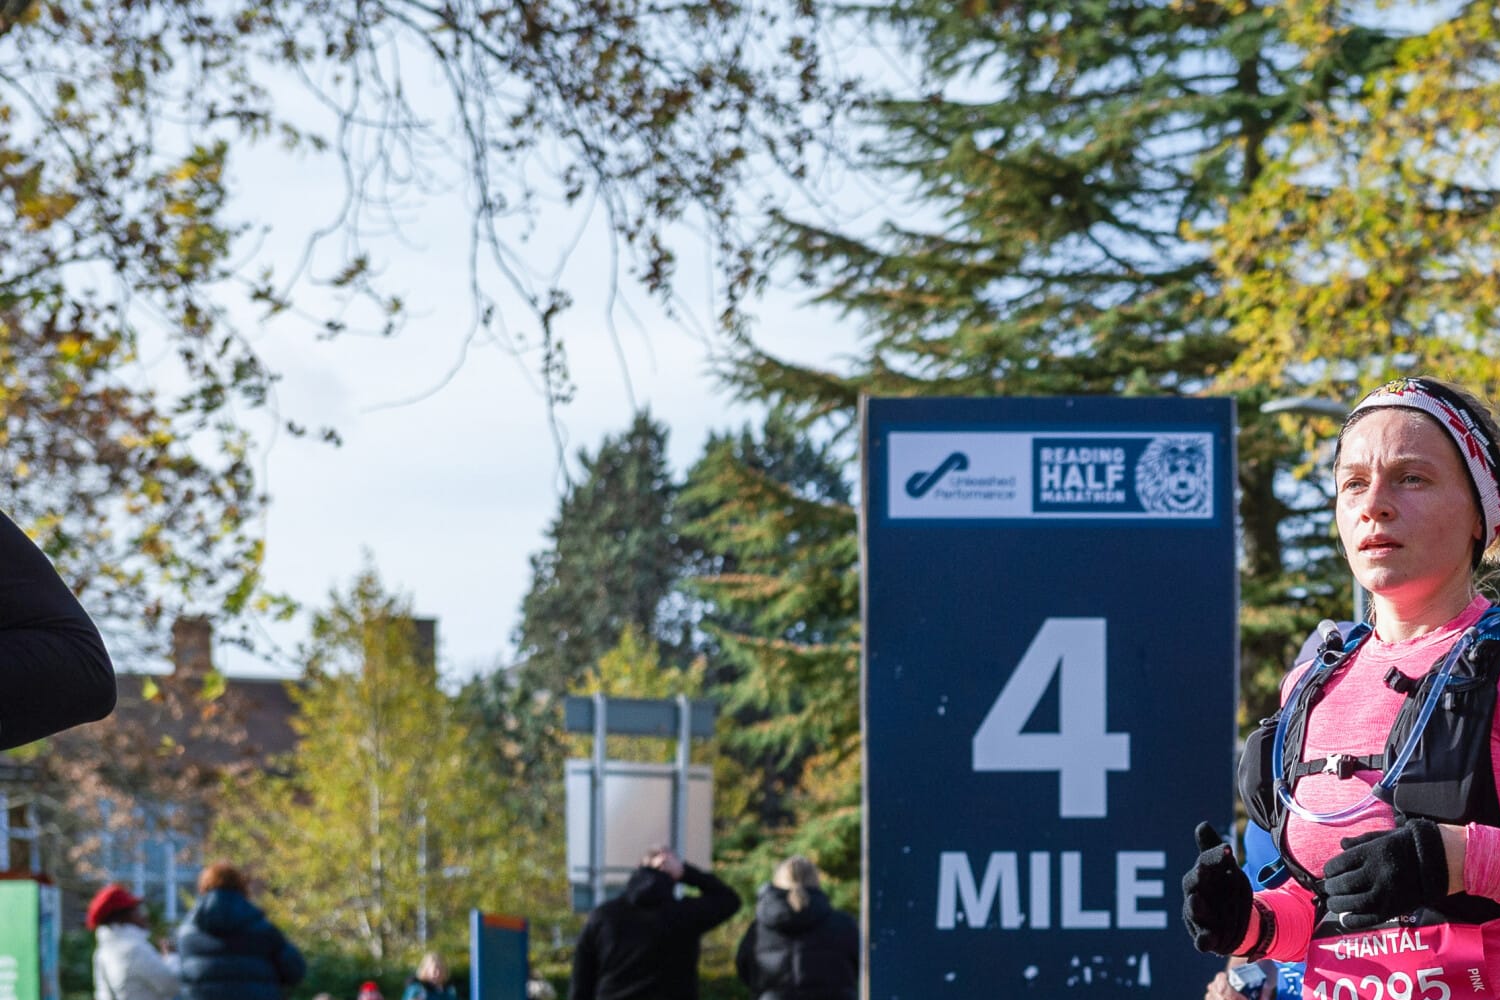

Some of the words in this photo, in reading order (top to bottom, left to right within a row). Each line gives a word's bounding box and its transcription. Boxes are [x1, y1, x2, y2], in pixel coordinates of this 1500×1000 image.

[1041, 447, 1126, 464] READING
[1041, 464, 1126, 490] HALF
[1041, 490, 1126, 503] MARATHON
[973, 618, 1130, 818] 4
[936, 852, 1167, 929] MILE
[1334, 931, 1429, 960] CHANTAL
[1467, 967, 1486, 993] PINK
